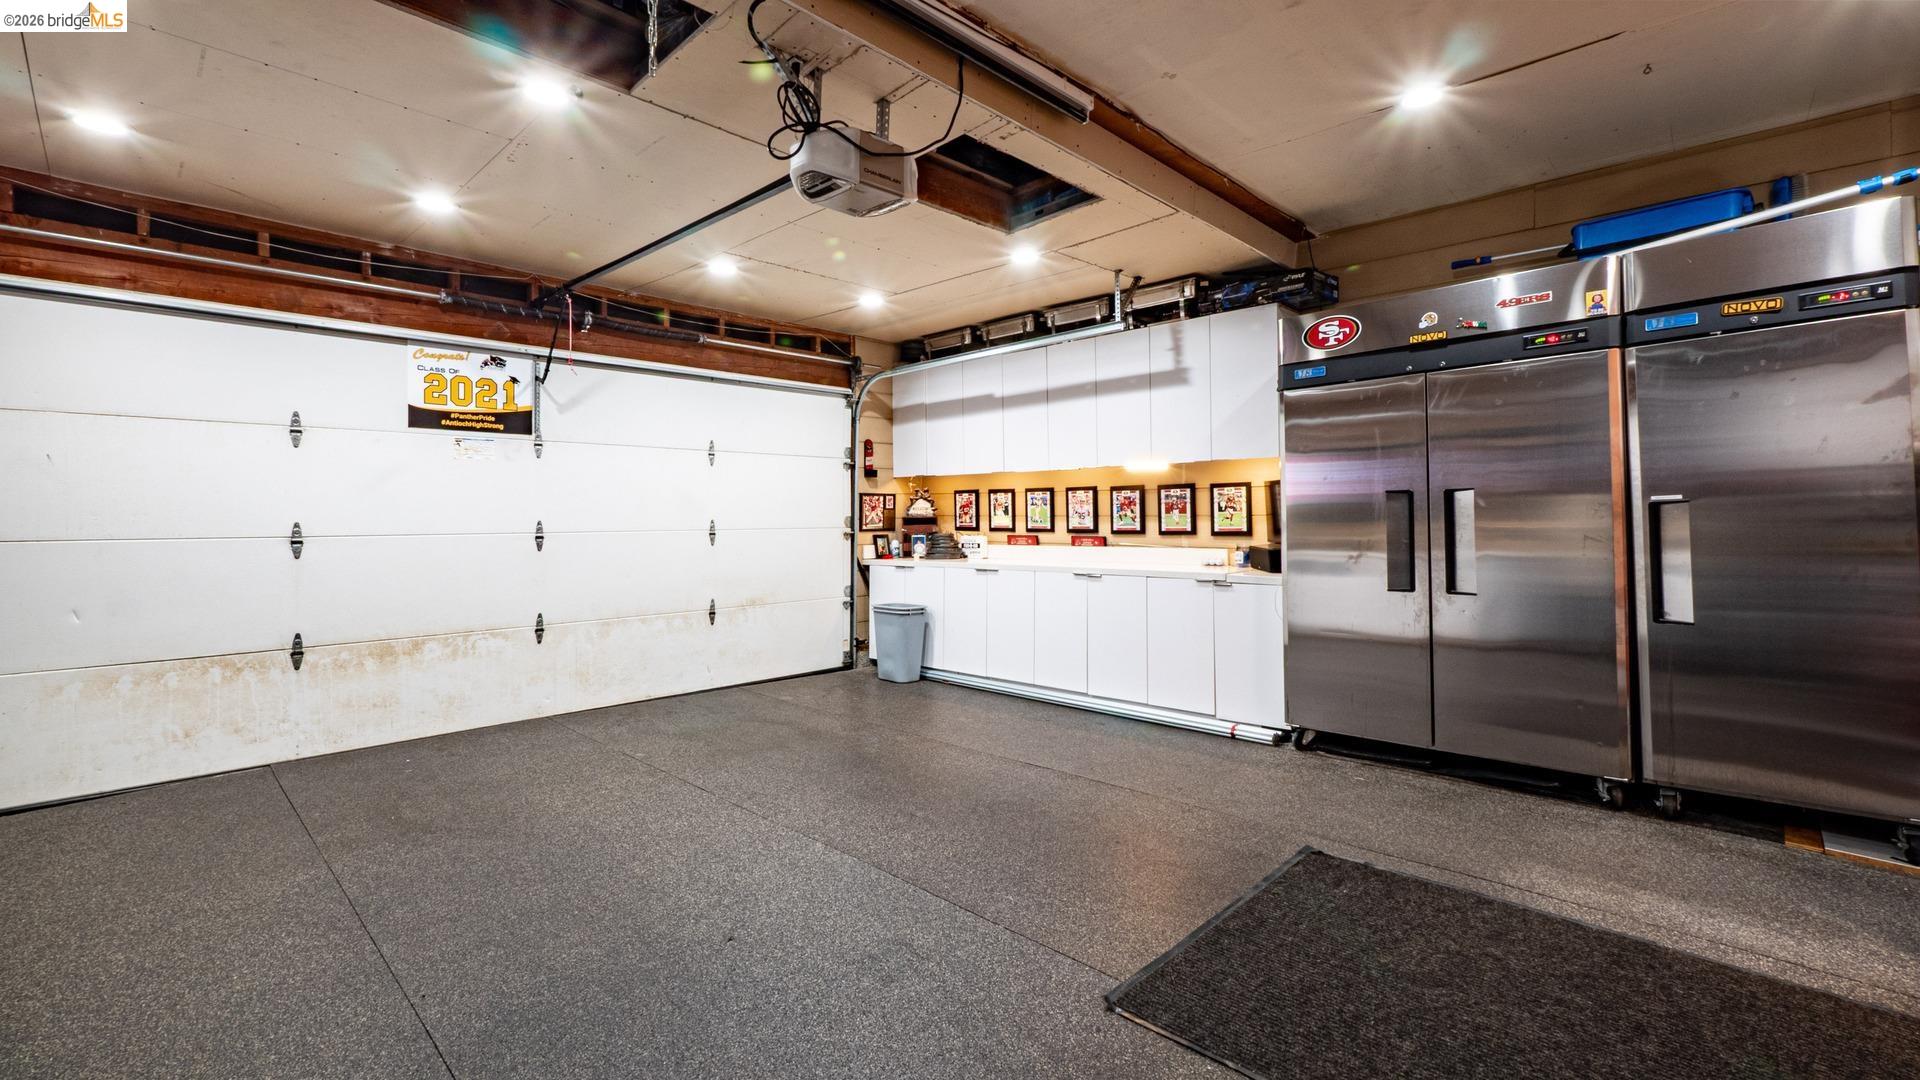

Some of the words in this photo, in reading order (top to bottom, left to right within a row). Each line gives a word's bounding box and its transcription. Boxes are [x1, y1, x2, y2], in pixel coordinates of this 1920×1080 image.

[1495, 292, 1551, 308] 49ERS
[1723, 297, 1783, 315] NOVO
[1318, 320, 1350, 346] SF
[1409, 331, 1447, 344] NOVO
[412, 348, 470, 362] Congrats!
[417, 364, 446, 373] CLASS
[423, 372, 518, 411] 2021
[450, 413, 496, 421] #PantherPride
[441, 420, 504, 430] #AntiochHighStrong
